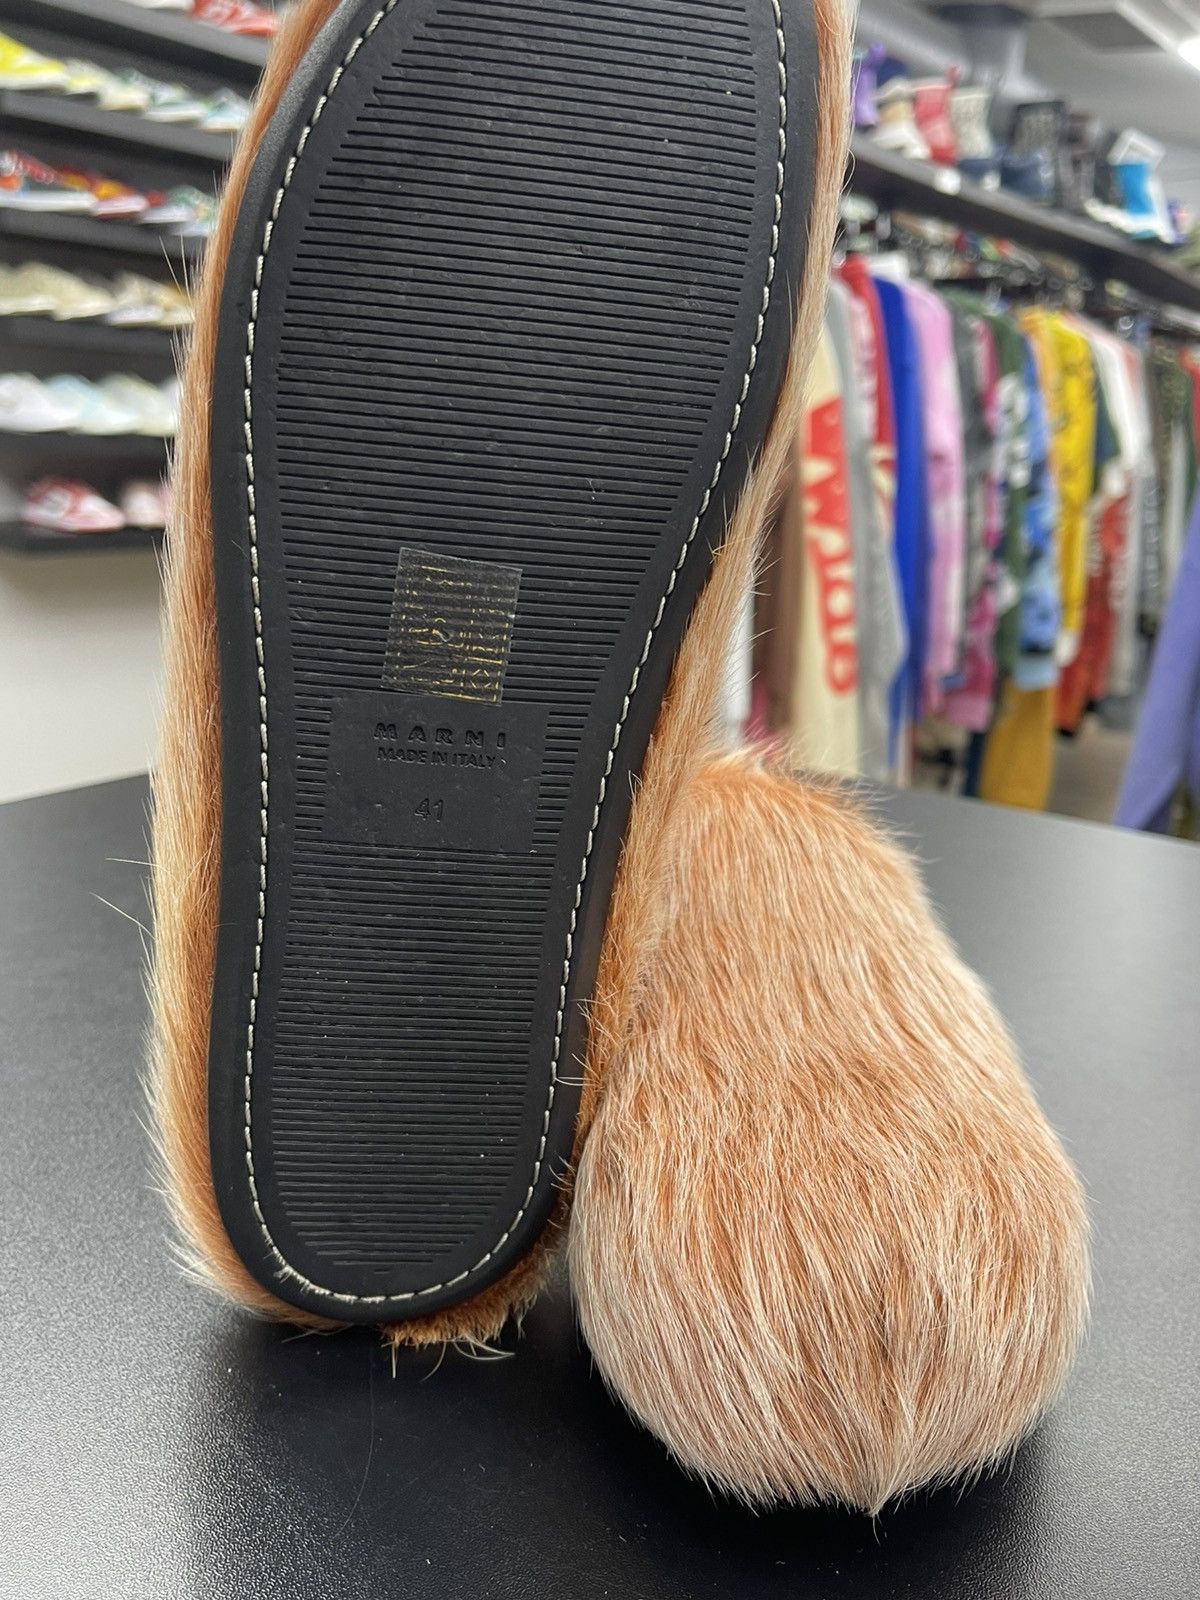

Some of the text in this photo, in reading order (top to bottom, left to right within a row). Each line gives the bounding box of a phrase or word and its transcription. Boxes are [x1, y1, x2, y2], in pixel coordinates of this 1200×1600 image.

[373, 722, 507, 750] MARNI
[377, 747, 496, 769] MADE IN ITALY
[414, 798, 444, 822] 41
